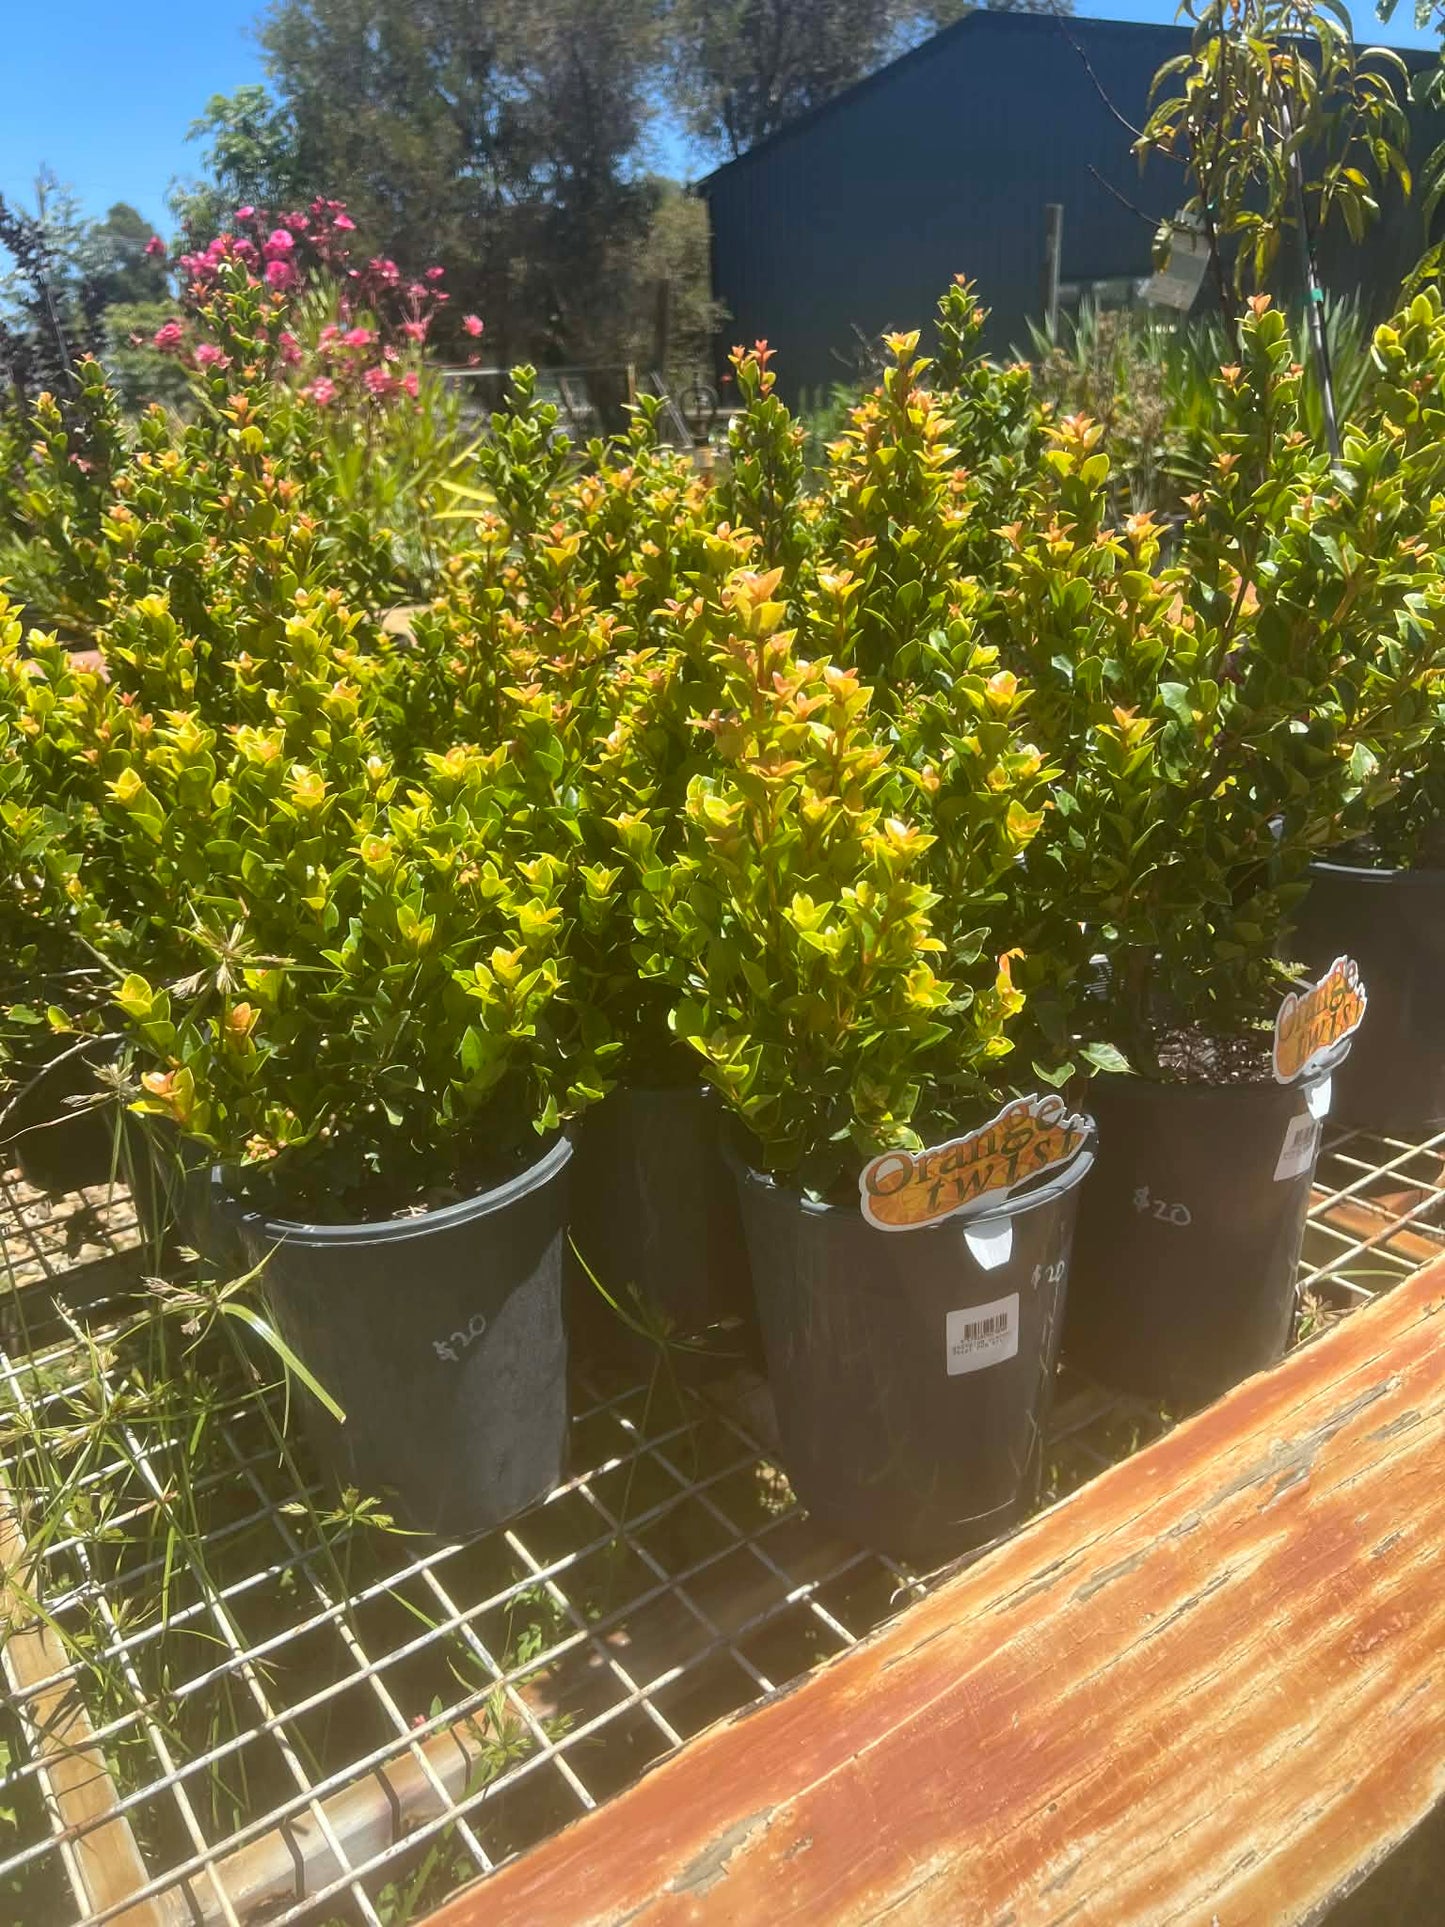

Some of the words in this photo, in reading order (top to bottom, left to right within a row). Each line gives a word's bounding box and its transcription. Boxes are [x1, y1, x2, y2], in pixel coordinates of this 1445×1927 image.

[866, 1100, 1064, 1196] Orange
[928, 1123, 1079, 1212] twist
[1133, 1186, 1192, 1226] $20
[432, 1314, 487, 1362] $20
